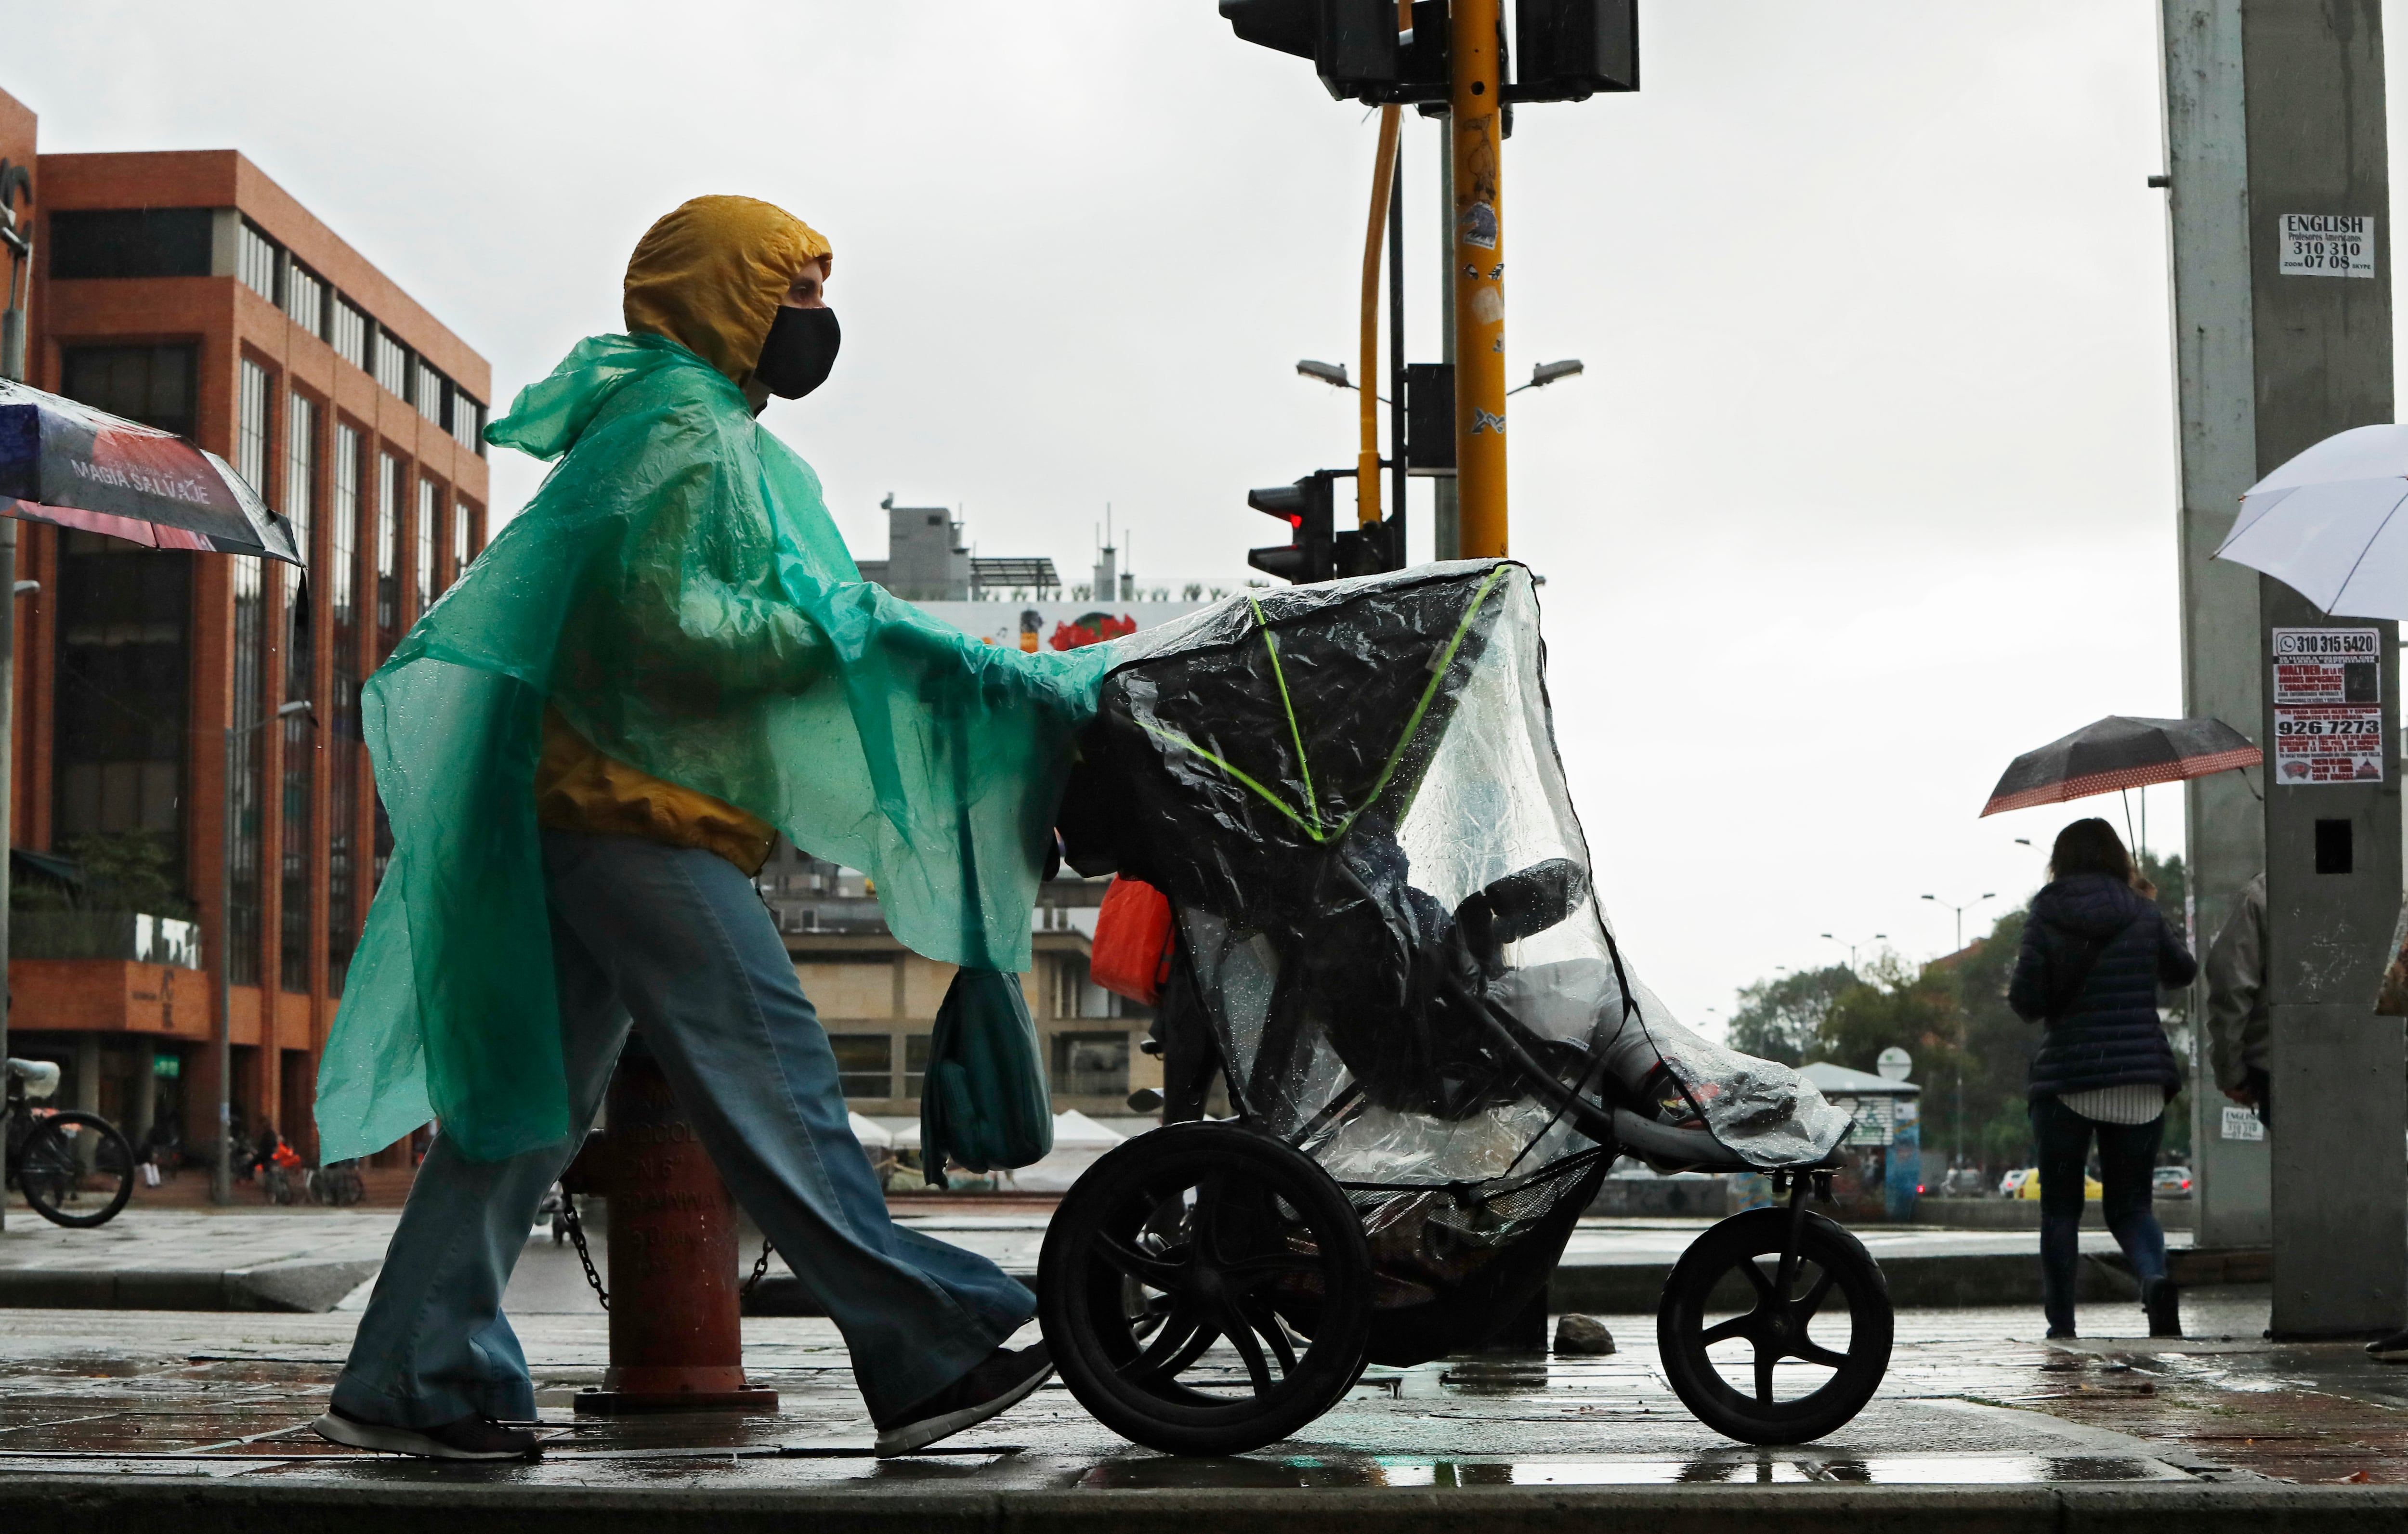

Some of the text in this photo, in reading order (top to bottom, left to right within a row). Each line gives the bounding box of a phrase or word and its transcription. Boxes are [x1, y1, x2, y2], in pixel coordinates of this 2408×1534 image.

[2288, 216, 2363, 233] ENGLISH
[2289, 233, 2323, 241] Profesores
[2294, 242, 2360, 255] 310 310
[2304, 255, 2324, 268] 07
[2329, 256, 2350, 269] 08
[70, 459, 211, 505] MAGIA SALVAJE
[2297, 636, 2373, 652] 310 315 5420
[2278, 720, 2379, 735] 926 7273
